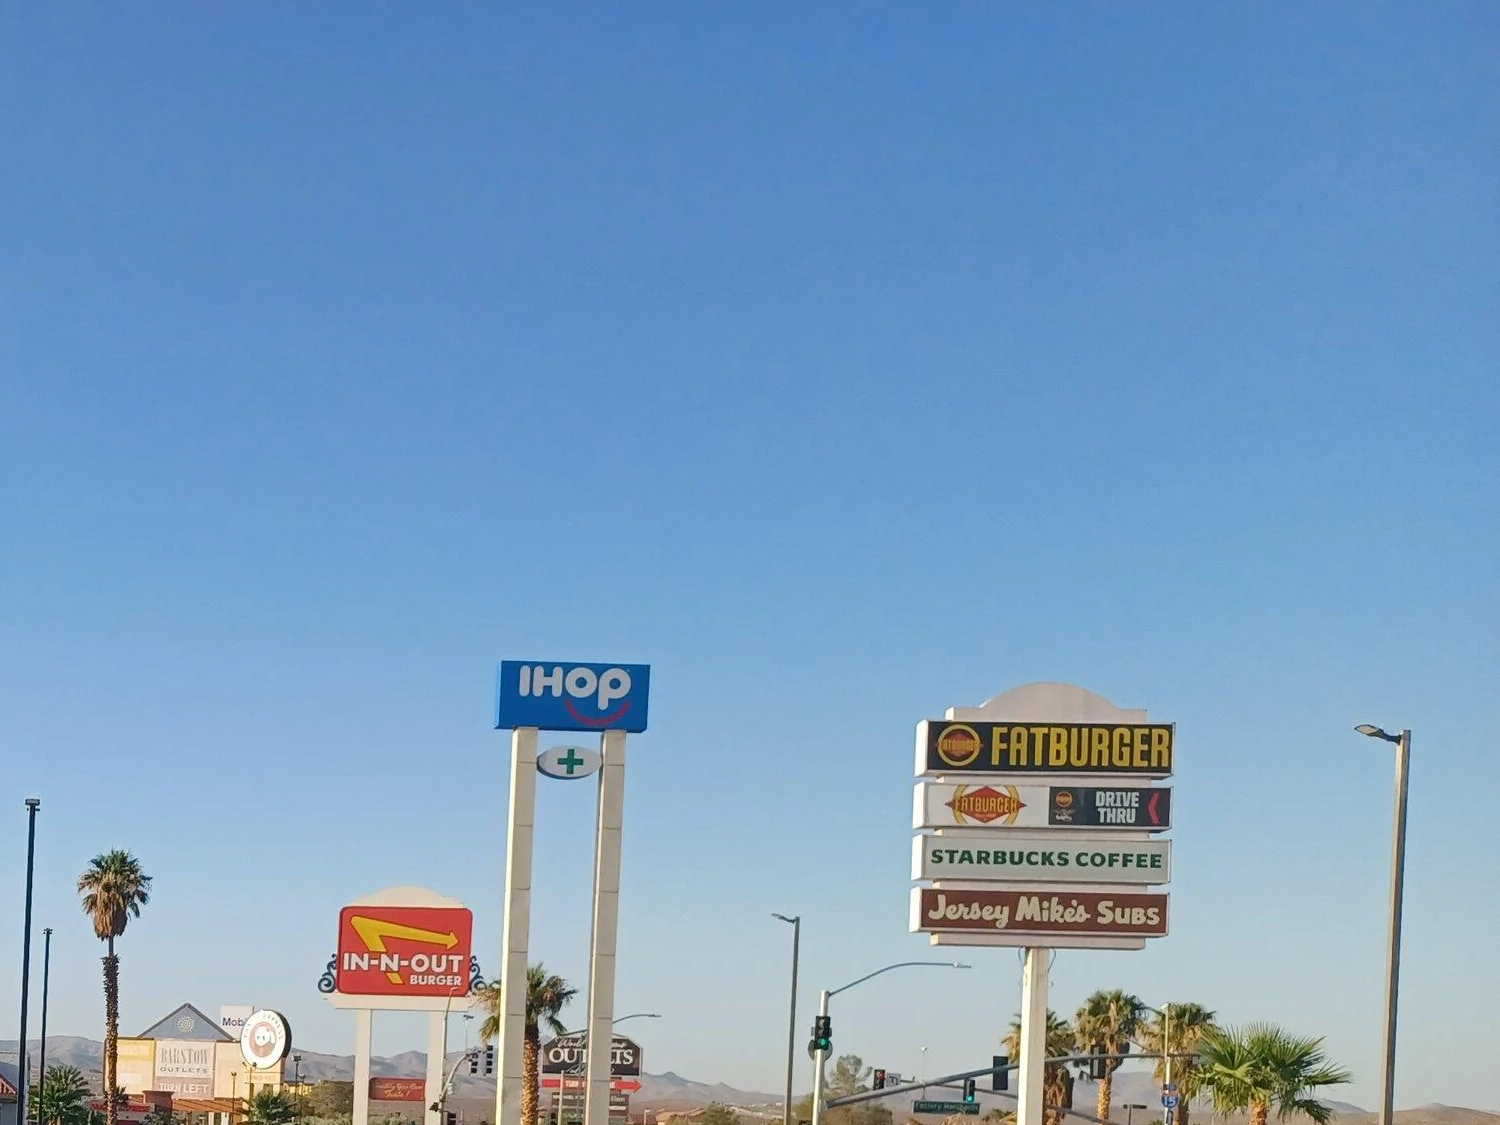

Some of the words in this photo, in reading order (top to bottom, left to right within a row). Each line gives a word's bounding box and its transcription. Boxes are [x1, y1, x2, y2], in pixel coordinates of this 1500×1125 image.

[519, 665, 631, 711] IHOP
[990, 726, 1170, 768] FATBURGER
[955, 797, 1017, 813] FATBURGER
[1095, 791, 1140, 808] DRIVE
[1098, 807, 1136, 824] THRU
[931, 849, 1070, 867] STARBUCKS
[1075, 852, 1162, 869] COFFEE
[928, 895, 1010, 928] Jersey
[1015, 896, 1091, 923] Mike's
[343, 953, 464, 974] IN-N-OUT
[409, 974, 462, 987] BURGER
[161, 1048, 208, 1064] BARSTOW
[160, 1066, 208, 1074] OUTLETS
[182, 1083, 210, 1094] LEFT
[1164, 1096, 1176, 1106] 15
